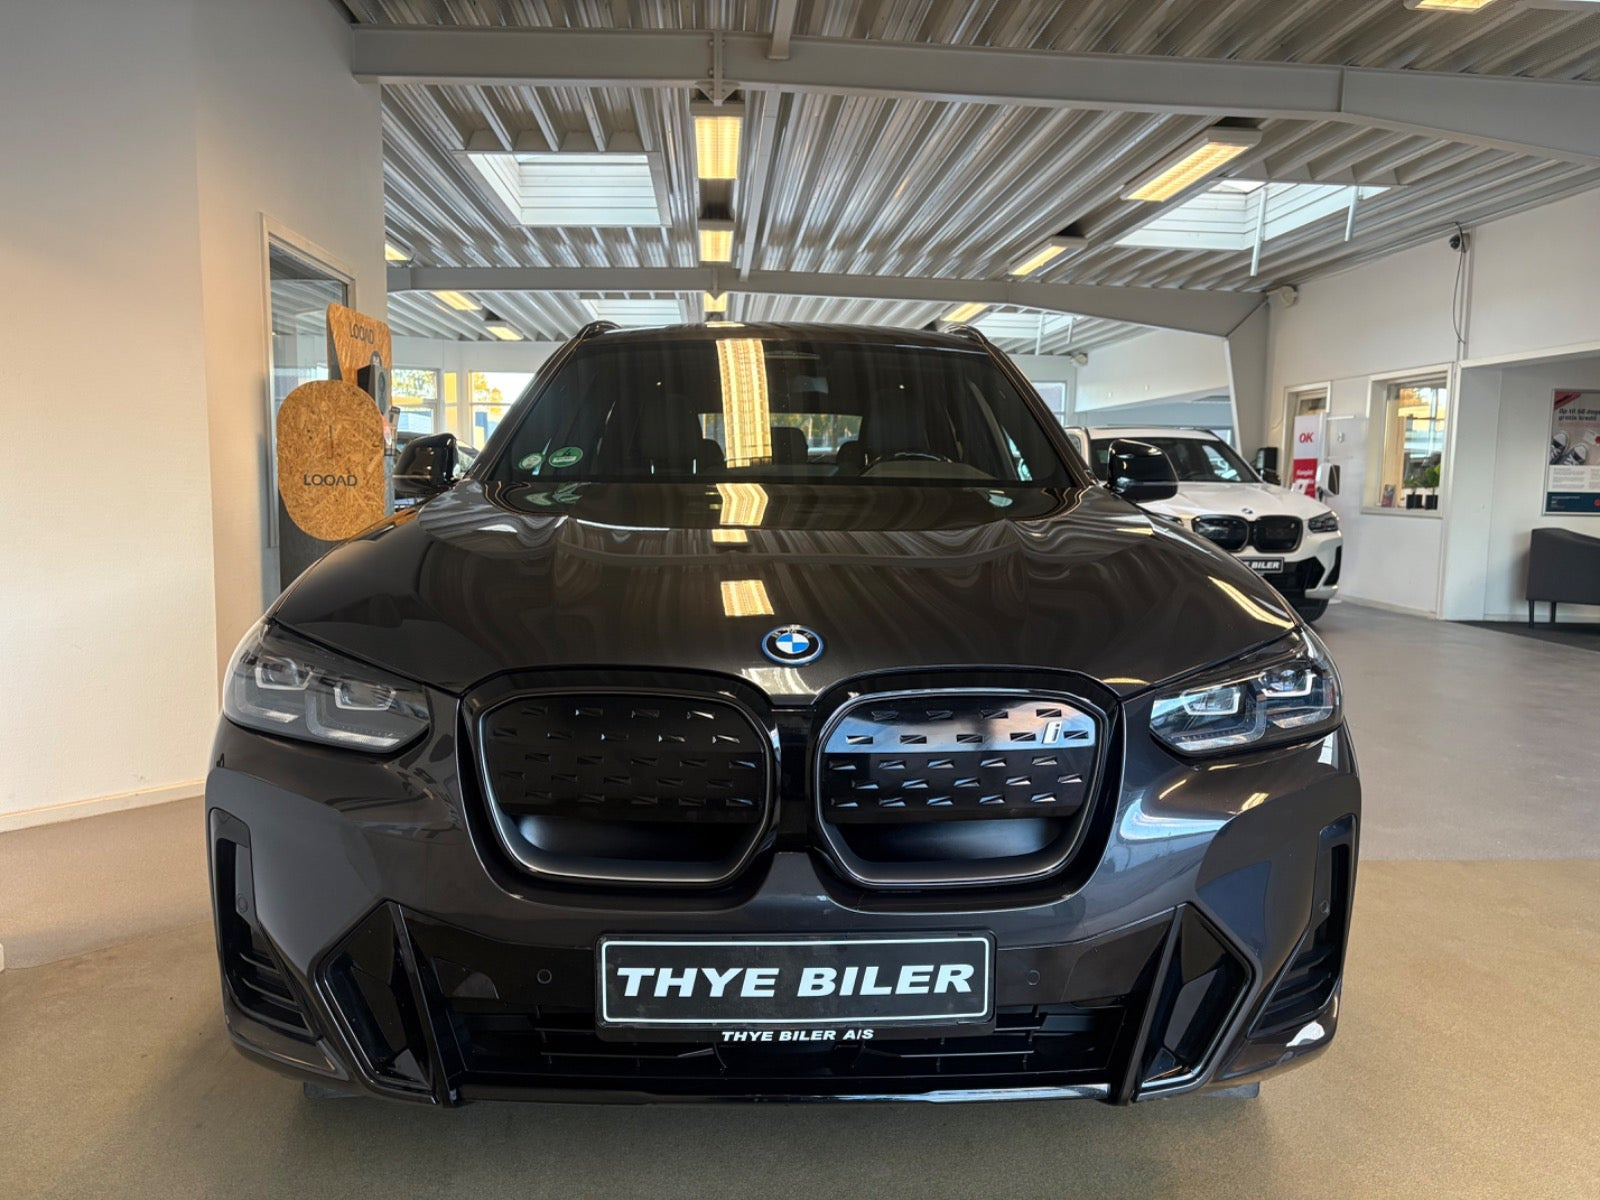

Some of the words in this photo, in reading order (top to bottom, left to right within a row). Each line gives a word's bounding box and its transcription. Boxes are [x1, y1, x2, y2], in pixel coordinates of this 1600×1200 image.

[350, 321, 374, 344] LOOAD
[1299, 432, 1314, 443] OK
[303, 474, 358, 486] LOOAD
[1251, 561, 1280, 569] BILER
[616, 967, 780, 998] THYE
[796, 964, 975, 998] BILER
[721, 1030, 774, 1042] THYE
[778, 1029, 837, 1042] BILER
[843, 1028, 875, 1041] A/S
